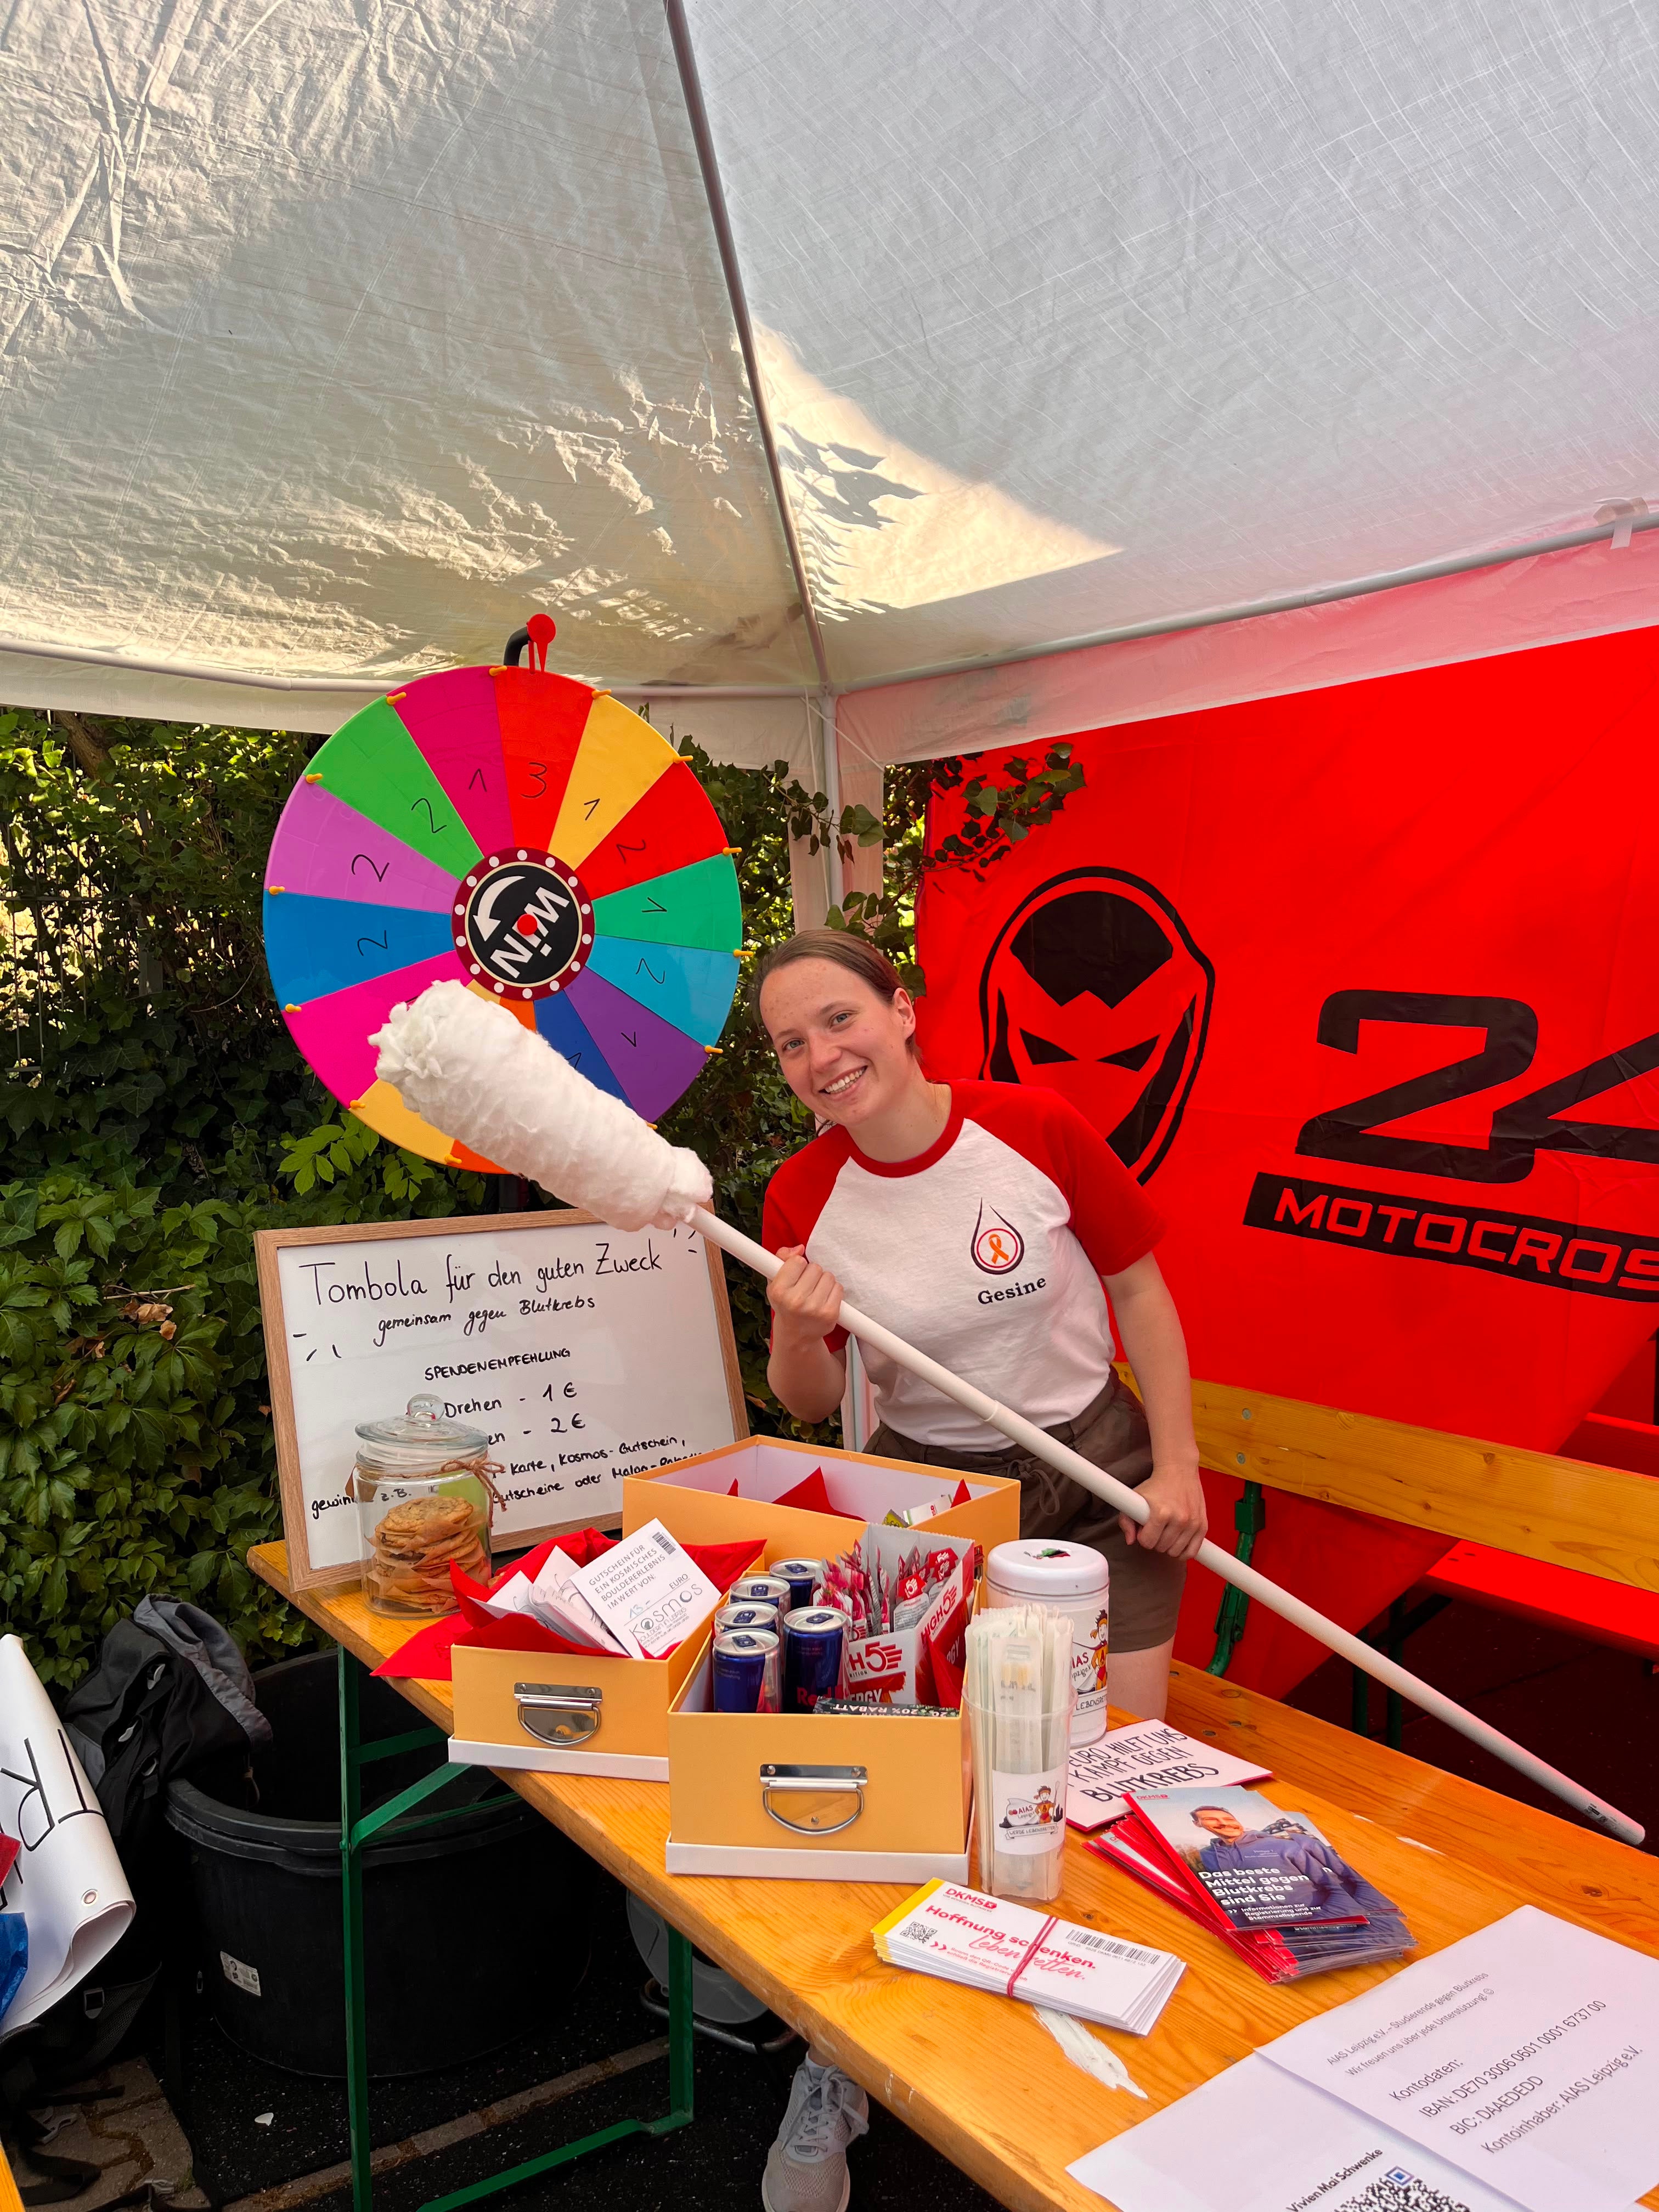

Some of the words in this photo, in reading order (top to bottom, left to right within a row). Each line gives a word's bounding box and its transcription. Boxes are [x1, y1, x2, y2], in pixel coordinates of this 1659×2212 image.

[520, 761, 548, 798] 3
[411, 798, 447, 833] 2
[583, 798, 601, 821] 1
[351, 854, 390, 882] 2
[357, 930, 387, 957] 2
[299, 1260, 428, 1305] Tombola
[445, 1254, 476, 1303] für
[488, 1260, 521, 1288] den
[536, 1257, 584, 1293] guten
[595, 1238, 662, 1276] Zweck
[978, 1278, 1046, 1305] Gesine
[373, 1313, 451, 1347] gemeinsam
[464, 1310, 506, 1336] gegen
[519, 1295, 595, 1315] Blutkrebs
[424, 1347, 571, 1381] SPENDENEMPFEHLUNG
[444, 1398, 502, 1418] Drehen
[575, 1474, 602, 1488] oder
[589, 1554, 631, 1586] GUTSCHEIN
[630, 1544, 646, 1558] FÜR
[595, 1582, 610, 1594] EIN
[610, 1548, 657, 1584] KOSMISCHES
[601, 1554, 666, 1601] BOULDERERLEBNIS
[669, 1573, 689, 1590] EURO
[607, 1599, 619, 1610] IM
[617, 1585, 639, 1602] WERT
[1071, 1652, 1089, 1668] IAS
[1105, 1736, 1153, 1755] HILFT
[1143, 1728, 1188, 1745] UNS
[1068, 1758, 1136, 1782] KAMPF
[1131, 1746, 1194, 1765] GEGEN
[1080, 1763, 1219, 1802] BLUTKREBS
[1198, 1870, 1232, 1880] Das
[1233, 1867, 1280, 1876] beste
[1205, 1876, 1256, 1888] Mittel
[1259, 1874, 1310, 1885] gegen
[945, 1888, 985, 1906] DKMS
[1212, 1884, 1294, 1897] Blutkrebs
[1220, 1895, 1256, 1905] sind
[1258, 1893, 1286, 1901] Sie
[1241, 1904, 1293, 1912] Informationen
[1245, 1908, 1294, 1917] Registrierung
[1248, 1911, 1313, 1921] Stammzellspende
[925, 1904, 1007, 1940] Hoffnung
[1008, 1935, 1096, 1970] scenken.
[979, 1961, 1014, 1976] Registrieru
[1327, 2051, 1348, 2066] AIAS
[1344, 2035, 1377, 2055] Leipzig
[1390, 2002, 1437, 2029] Studierende
[1435, 1990, 1457, 2006] gegen
[1453, 1972, 1489, 1993] Blutkrebs
[1345, 2066, 1363, 2076] Wir
[1361, 2051, 1389, 2069] freuen
[1386, 2043, 1404, 2055] uns
[1401, 2032, 1421, 2046] über
[1418, 2023, 1438, 2037] jede
[1433, 1993, 1487, 2026] Unterstützung!
[1419, 2095, 1459, 2118] IBAN:
[1452, 2075, 1488, 2100] DE70
[1483, 2058, 1517, 2080] 3006
[1510, 2041, 1543, 2062] 0601
[1537, 2025, 1568, 2045] 0001
[1562, 2008, 1592, 2028] 6737
[1588, 2000, 1606, 2012] 00
[1389, 2058, 1464, 2101] Kontodaten:
[1449, 2116, 1482, 2135] BIC:
[1475, 2075, 1543, 2120] DAAEDEDD
[1481, 2100, 1566, 2154] Kontoinhaber:
[1559, 2081, 1590, 2104] AIAS
[1583, 2056, 1629, 2086] Leipzig
[1621, 2045, 1643, 2061] e.V.
[1285, 2190, 1323, 2212] Vivien
[1317, 2176, 1340, 2193] Mai
[1335, 2149, 1383, 2180] Schwenke
